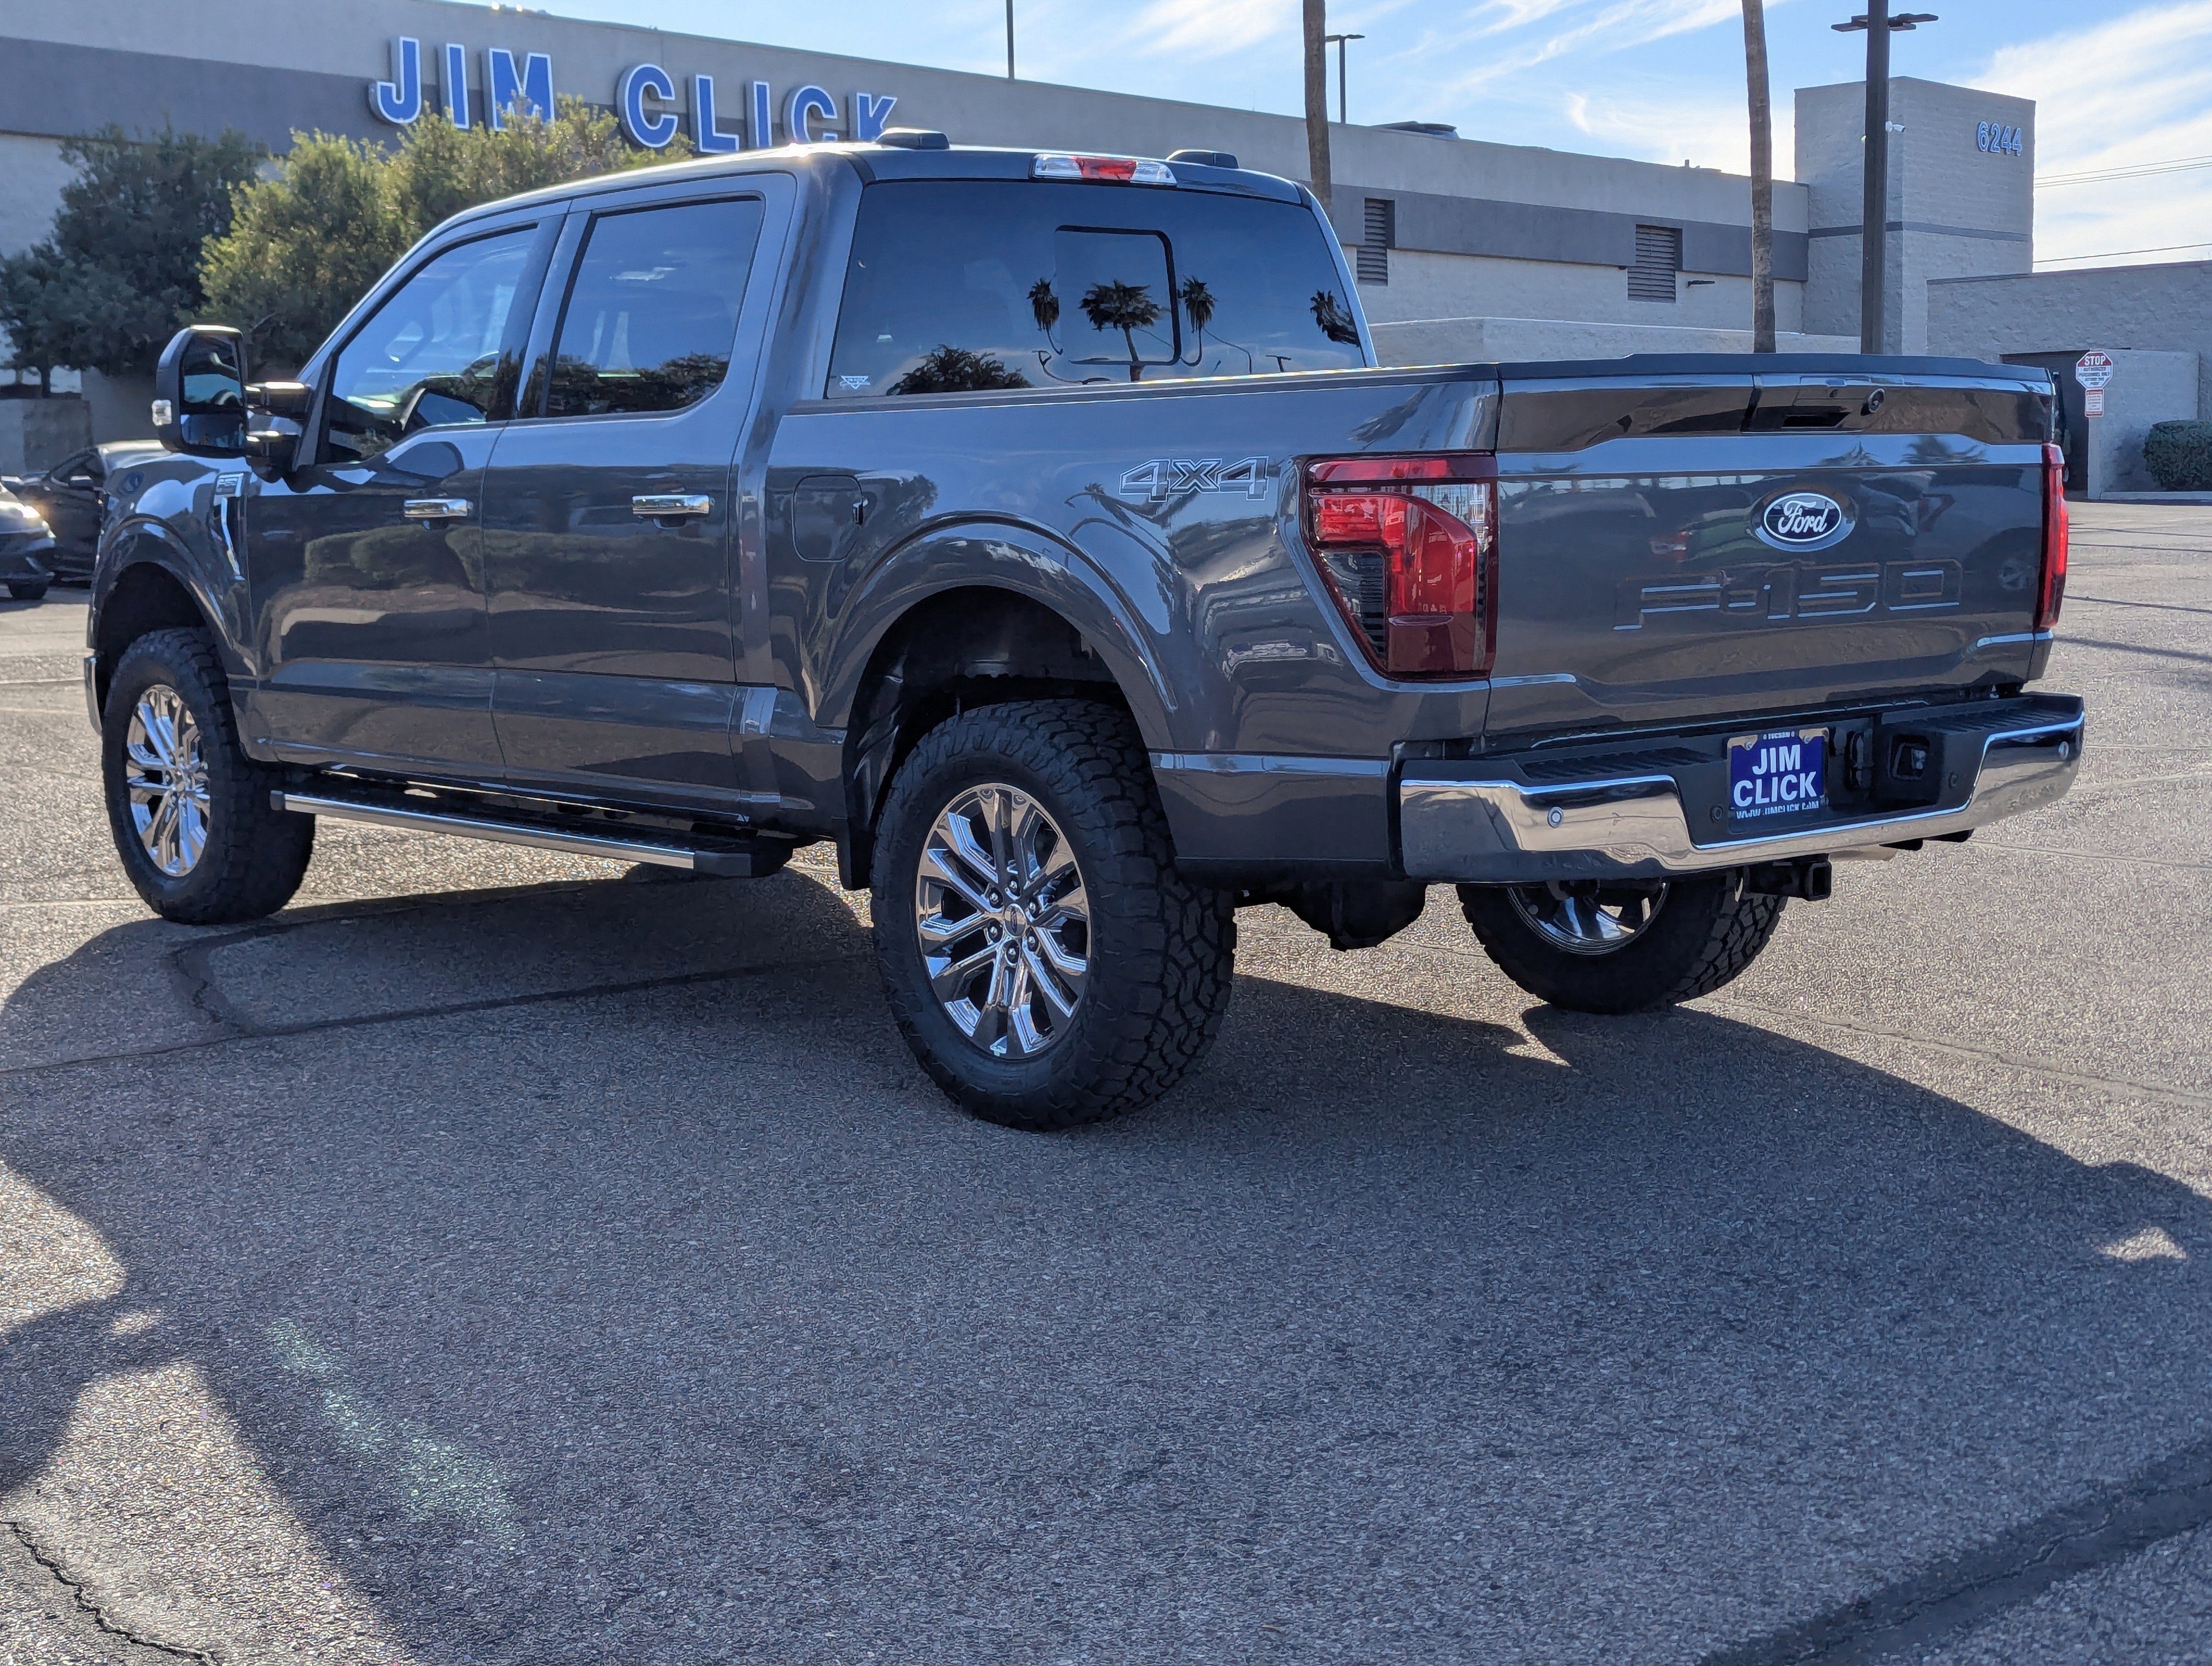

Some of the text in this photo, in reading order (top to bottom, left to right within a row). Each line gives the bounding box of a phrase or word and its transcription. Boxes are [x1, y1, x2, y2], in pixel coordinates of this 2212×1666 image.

[370, 36, 898, 153] JIM CLICK
[1978, 120, 2023, 156] 6244
[2085, 356, 2106, 366] STOP
[1778, 500, 1828, 534] Ford
[1752, 745, 1801, 775] JIM
[1733, 771, 1817, 807] CLICK
